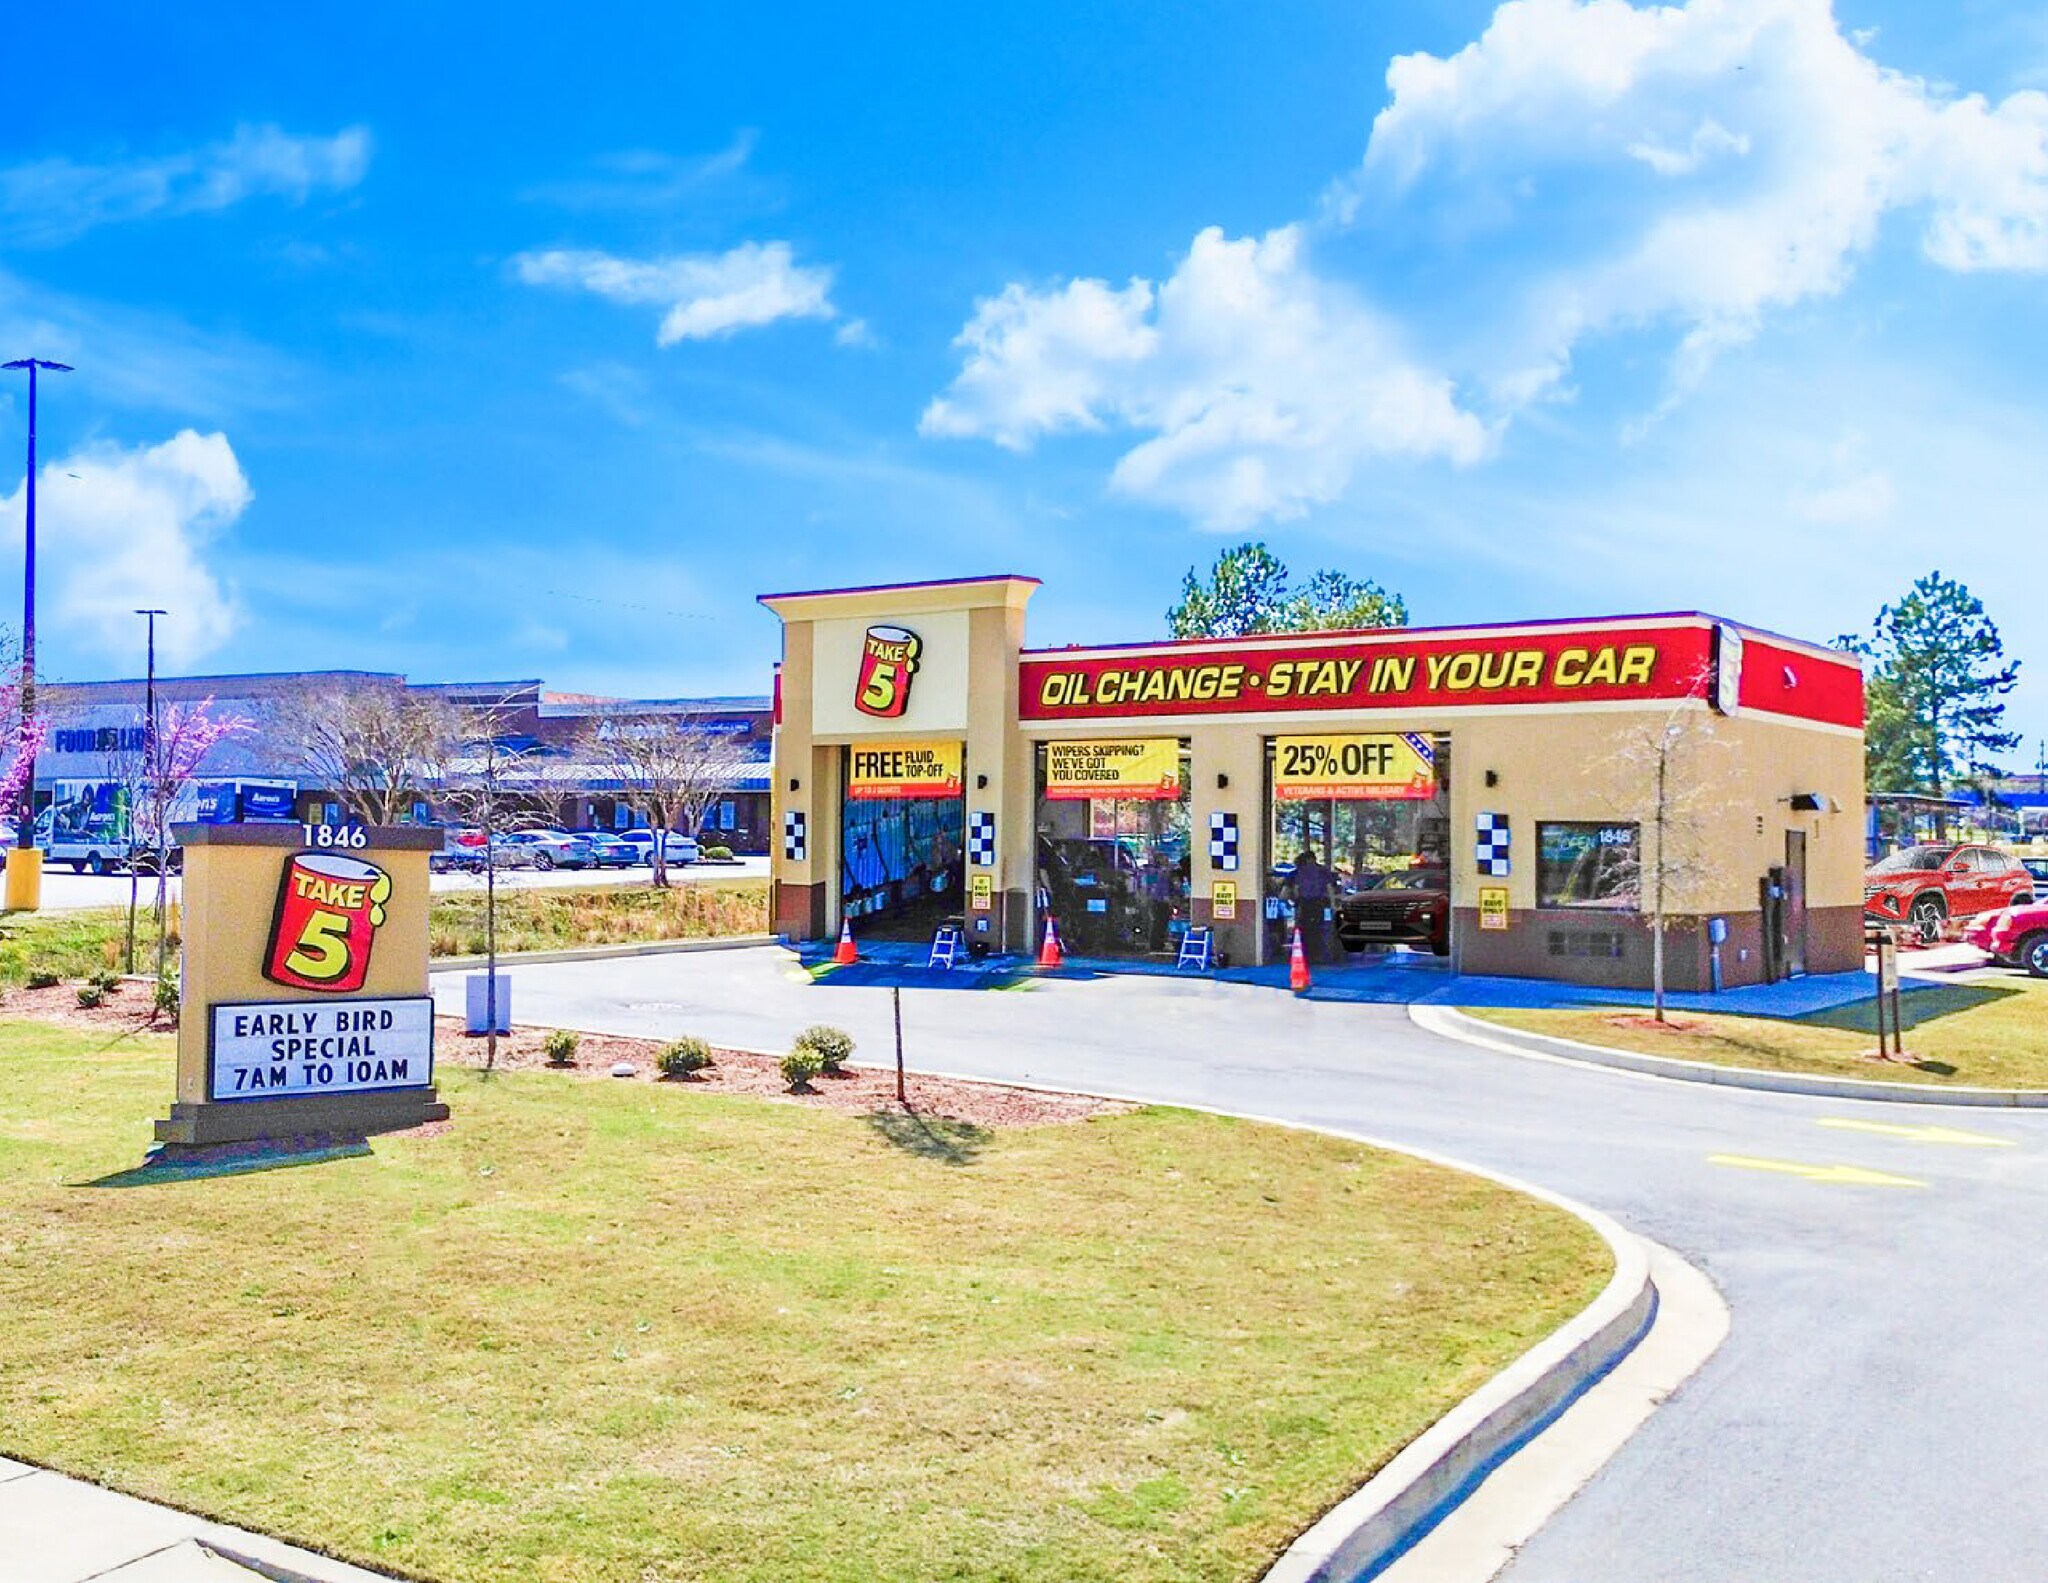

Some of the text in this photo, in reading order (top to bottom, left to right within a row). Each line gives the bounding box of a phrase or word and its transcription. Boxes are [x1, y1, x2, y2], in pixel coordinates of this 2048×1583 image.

[868, 640, 905, 661] TAKE
[862, 662, 895, 709] 5
[1041, 647, 1656, 705] OIL CHANGE STAY IN YOUR CAR
[56, 730, 95, 752] FOOD
[1052, 745, 1145, 757] WIPERS SKIPPING?
[855, 751, 903, 778] FREE
[905, 751, 934, 763] FLUID
[1052, 758, 1106, 769] WE'VE GOT
[1283, 743, 1394, 776] 25% OFF
[905, 764, 943, 777] TOP-OFF
[1052, 769, 1119, 780] YOU COVERED
[302, 824, 367, 848] 1846
[1600, 828, 1631, 843] 1846
[294, 872, 366, 908] TAKE
[285, 910, 350, 979] 5
[234, 1010, 393, 1037] EARLY BIRD
[271, 1036, 375, 1062] SPECIAL
[234, 1066, 287, 1090] 7AM
[302, 1063, 333, 1085] TO
